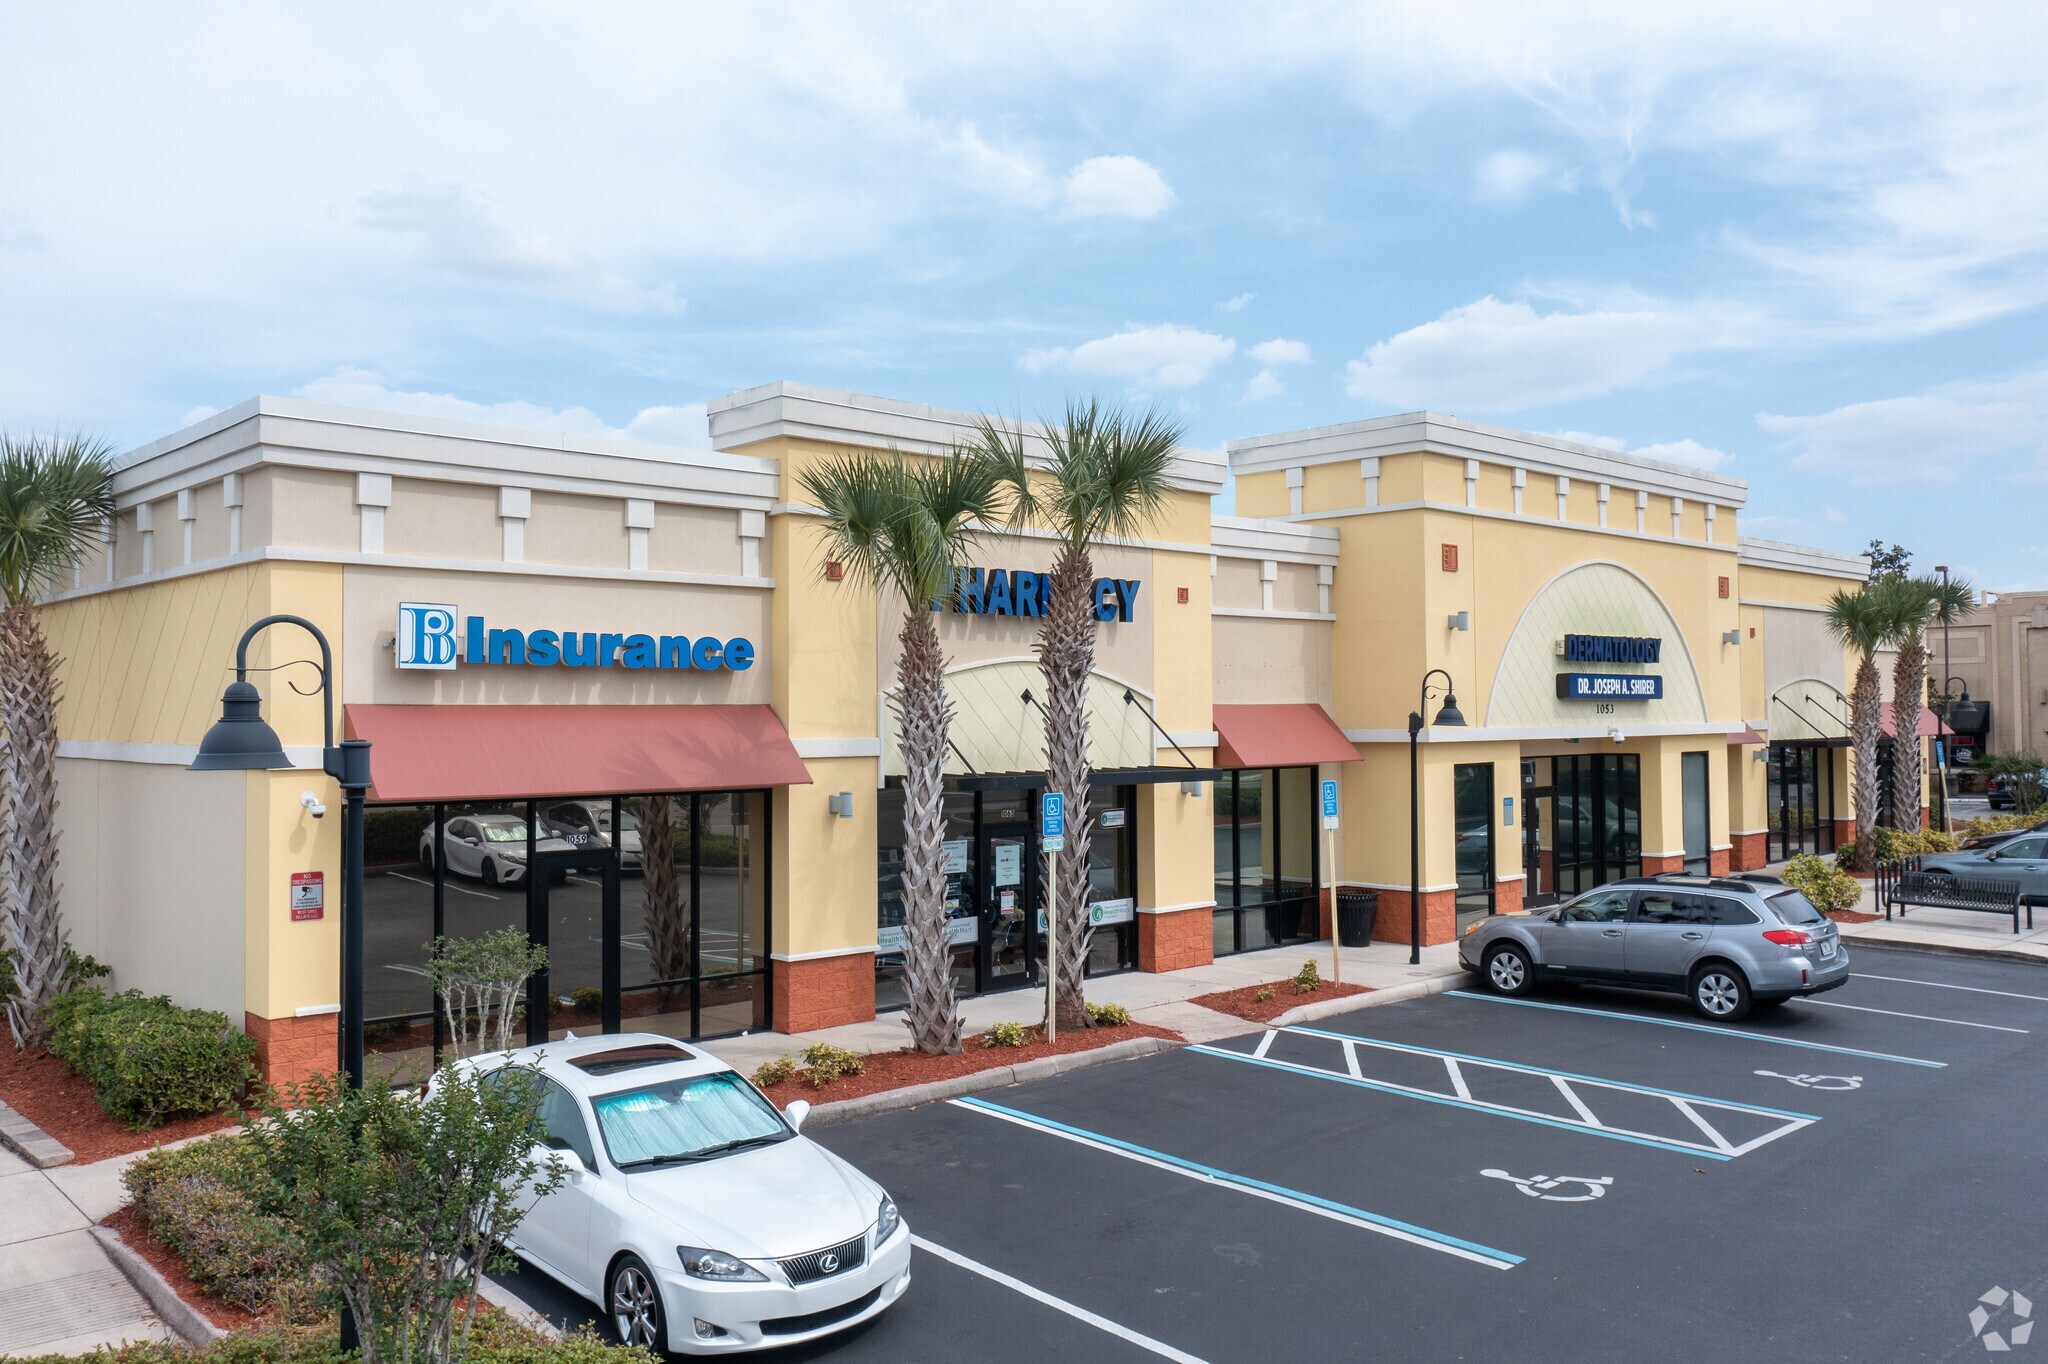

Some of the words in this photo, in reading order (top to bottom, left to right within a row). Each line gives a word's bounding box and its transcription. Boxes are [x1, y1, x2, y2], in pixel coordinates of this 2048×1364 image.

[466, 615, 755, 672] Insurance
[1566, 633, 1662, 664] DERMATOLOGY
[1577, 678, 1592, 695] DR.
[1593, 679, 1621, 695] JOSEPH
[1622, 679, 1630, 695] A.
[1630, 679, 1655, 695] SHIRER
[1596, 703, 1614, 714] 1053
[567, 834, 587, 844] 1059
